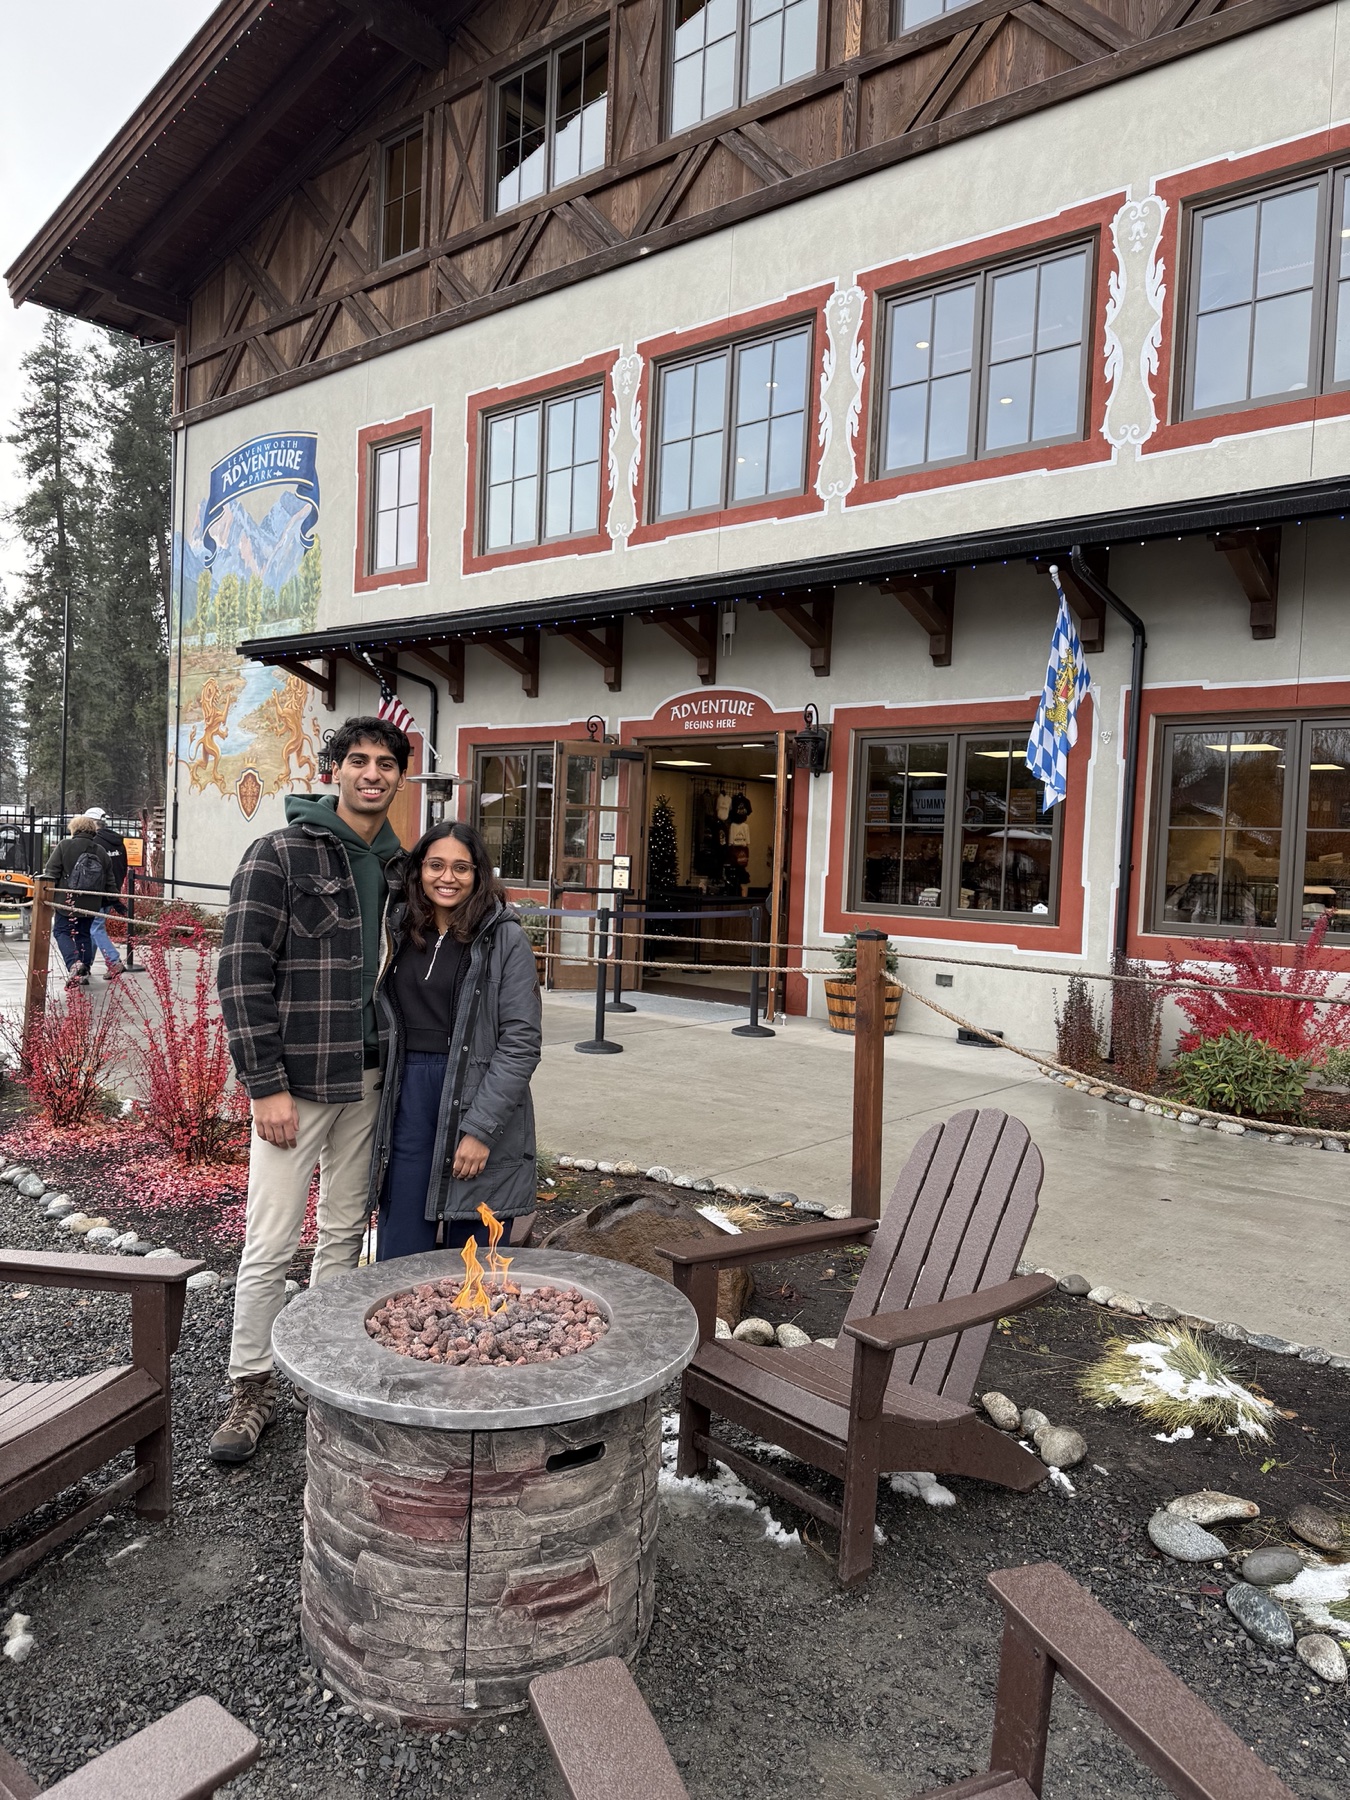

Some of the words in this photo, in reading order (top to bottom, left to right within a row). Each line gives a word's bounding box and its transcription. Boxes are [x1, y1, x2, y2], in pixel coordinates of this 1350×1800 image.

[228, 440, 298, 468] LEAVENWORTH
[221, 449, 303, 493] ADVENTURE
[248, 469, 273, 484] PARK
[670, 699, 755, 721] ADVENTURE
[684, 720, 714, 730] BEGINS
[716, 719, 736, 728] HERE
[915, 798, 946, 810] YUMMY
